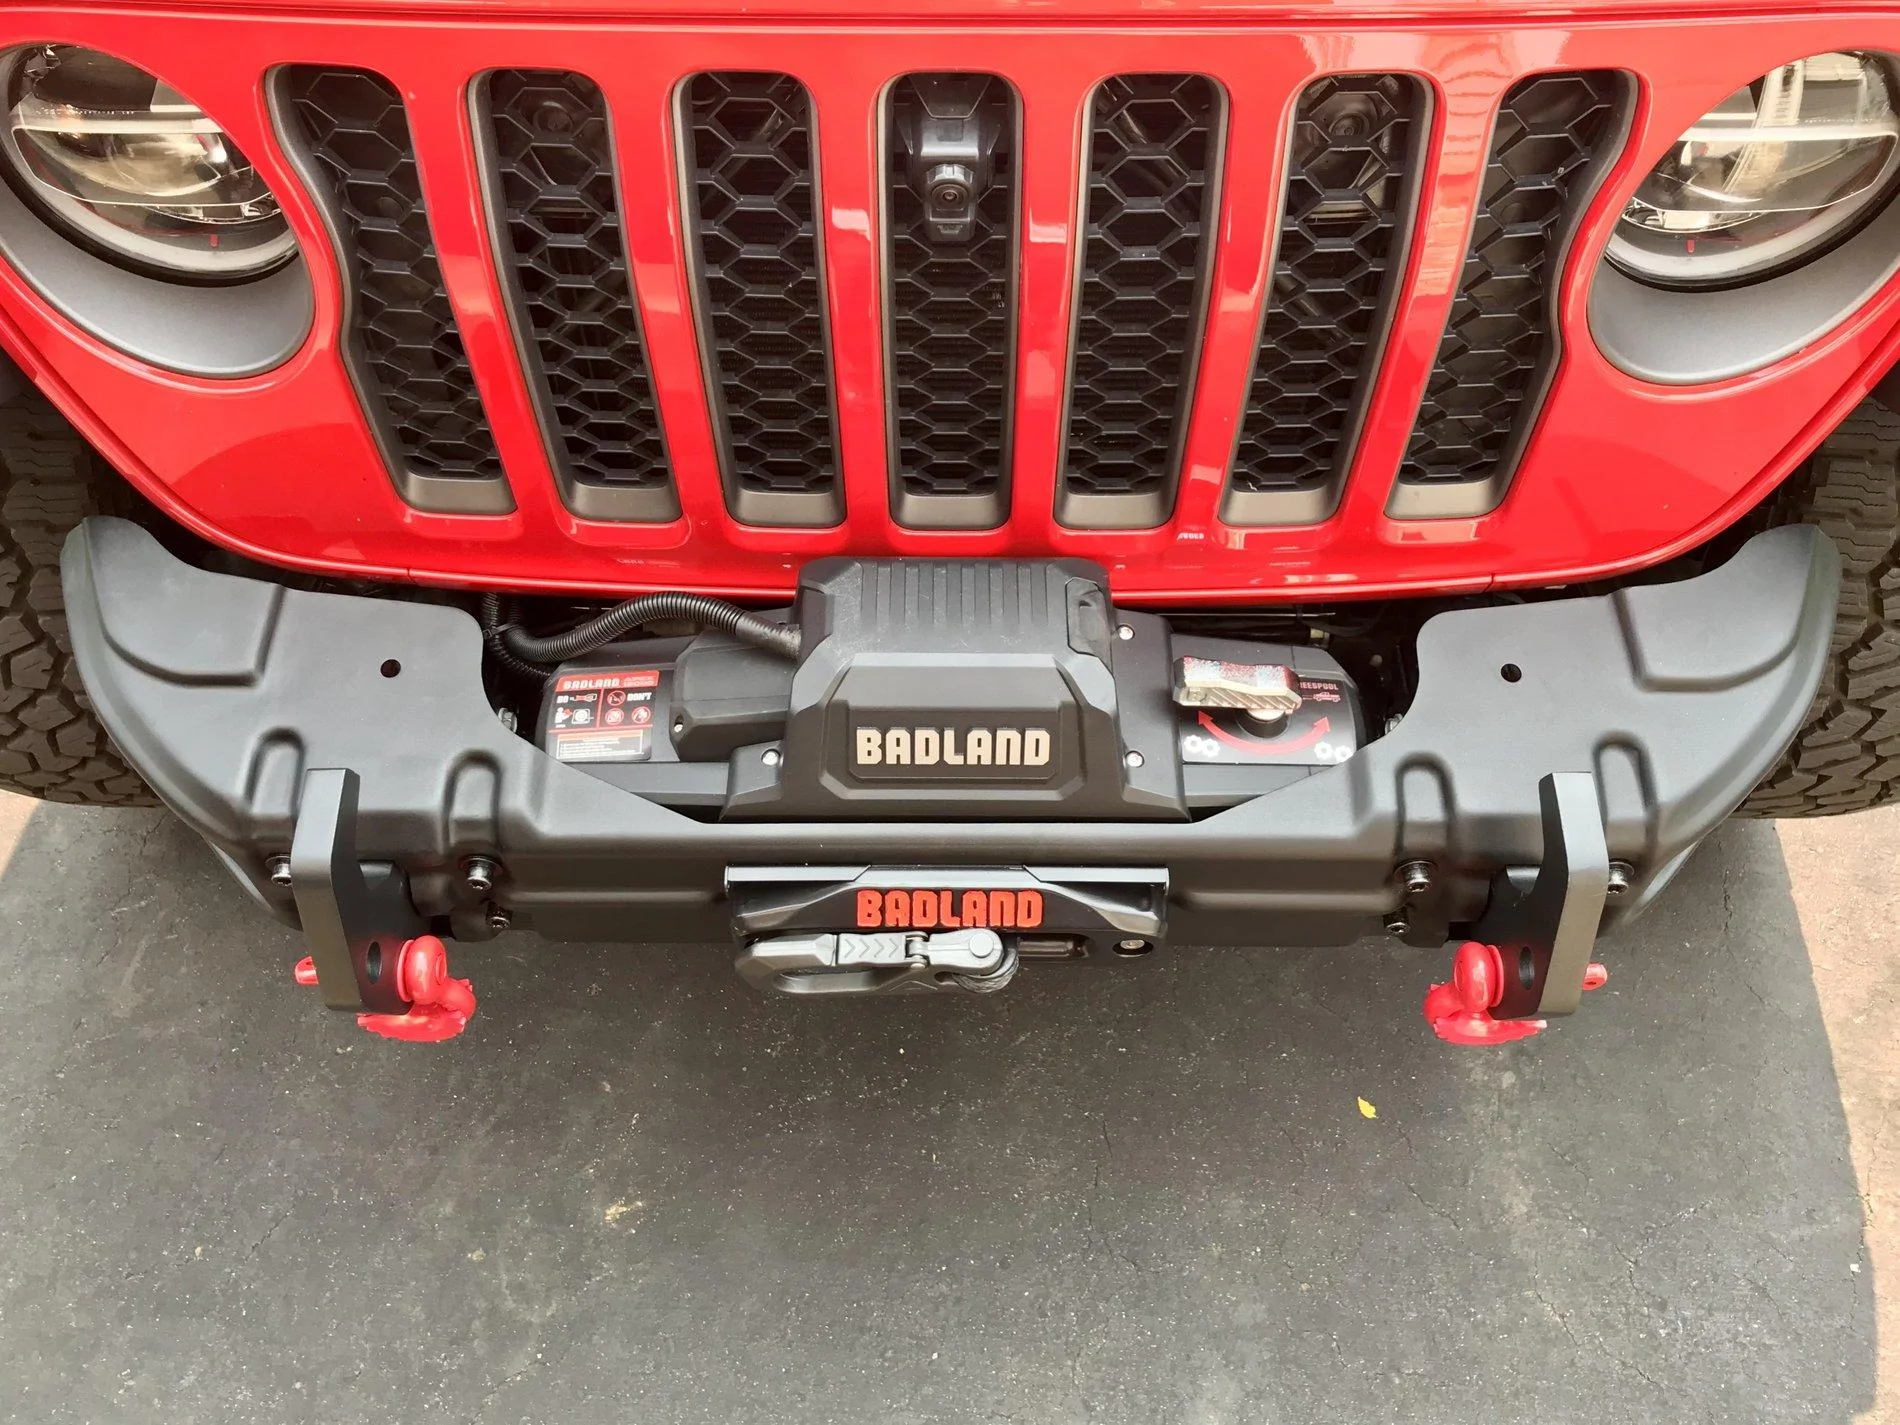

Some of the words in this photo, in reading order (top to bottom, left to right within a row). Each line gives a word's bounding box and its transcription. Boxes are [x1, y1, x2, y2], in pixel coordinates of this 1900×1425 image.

[563, 678, 620, 689] BADLAND
[856, 727, 1050, 765] BADLAND
[856, 889, 1043, 928] BADLAND
